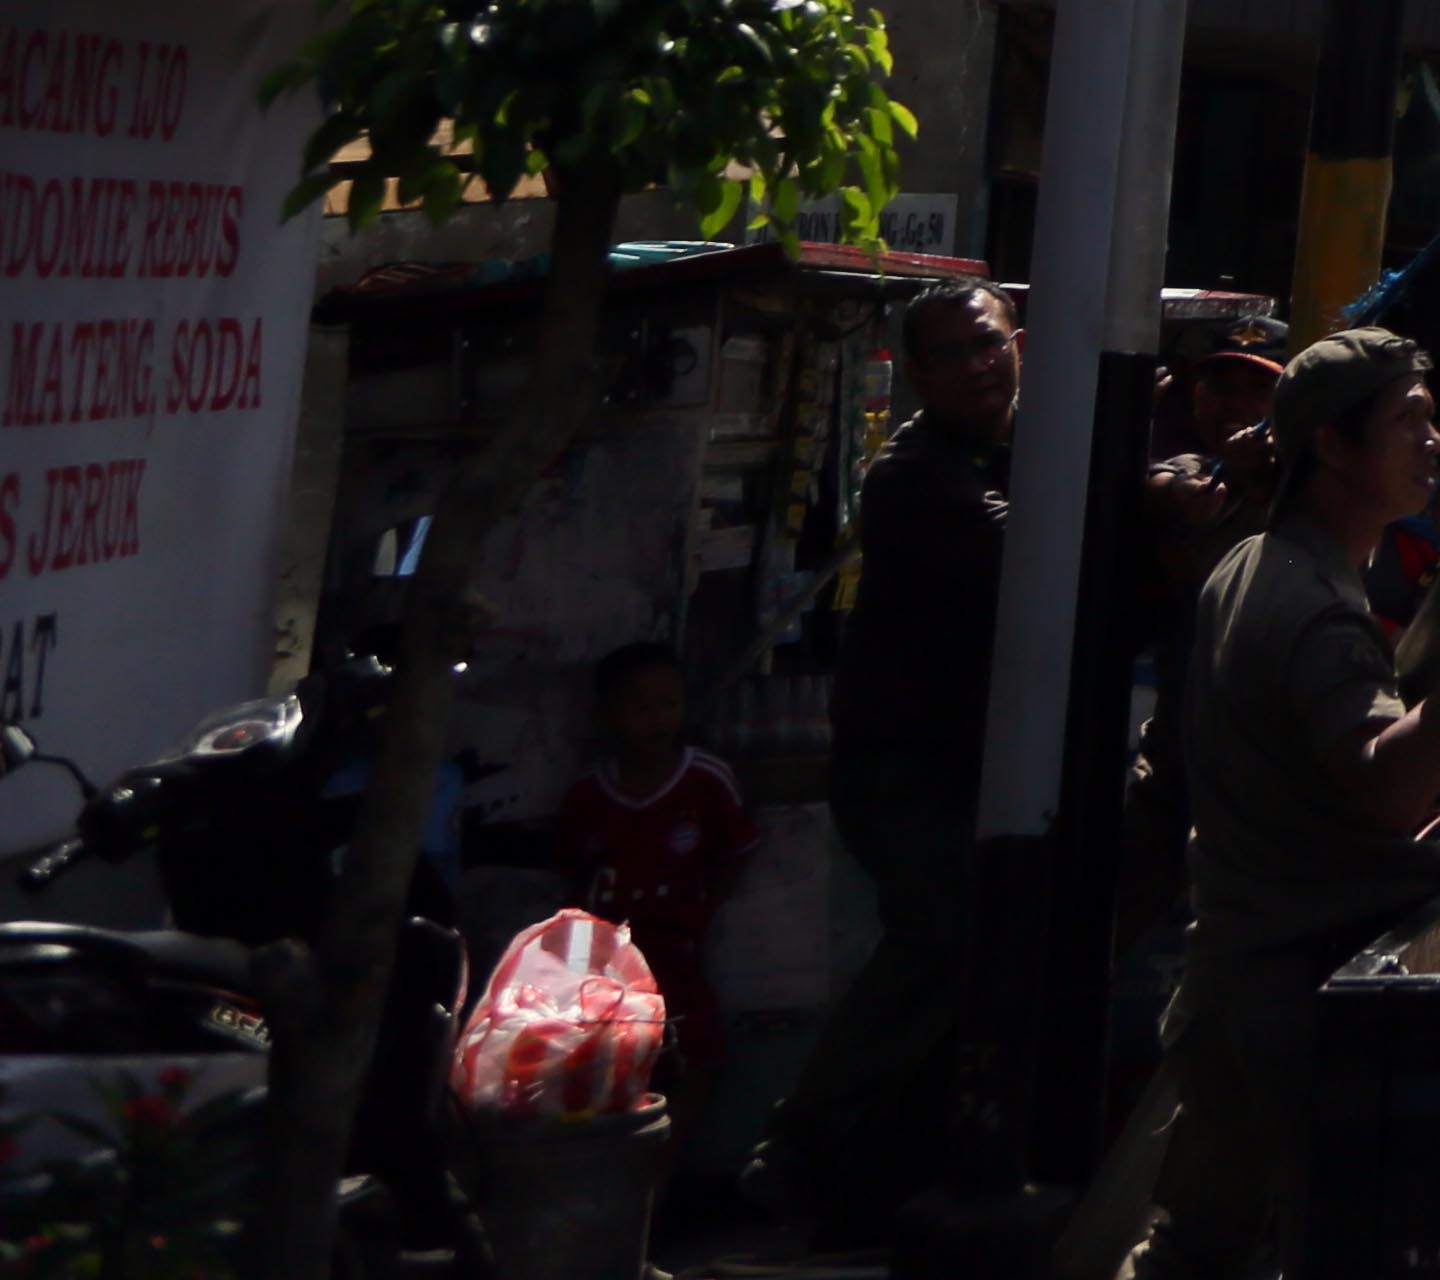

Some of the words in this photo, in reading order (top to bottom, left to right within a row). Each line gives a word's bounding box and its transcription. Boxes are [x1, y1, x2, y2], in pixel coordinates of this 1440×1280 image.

[128, 41, 188, 142] IJO
[138, 180, 243, 279] REBUS
[166, 316, 263, 414] SODA
[27, 458, 147, 577] JERUK
[0, 612, 58, 720] AT
